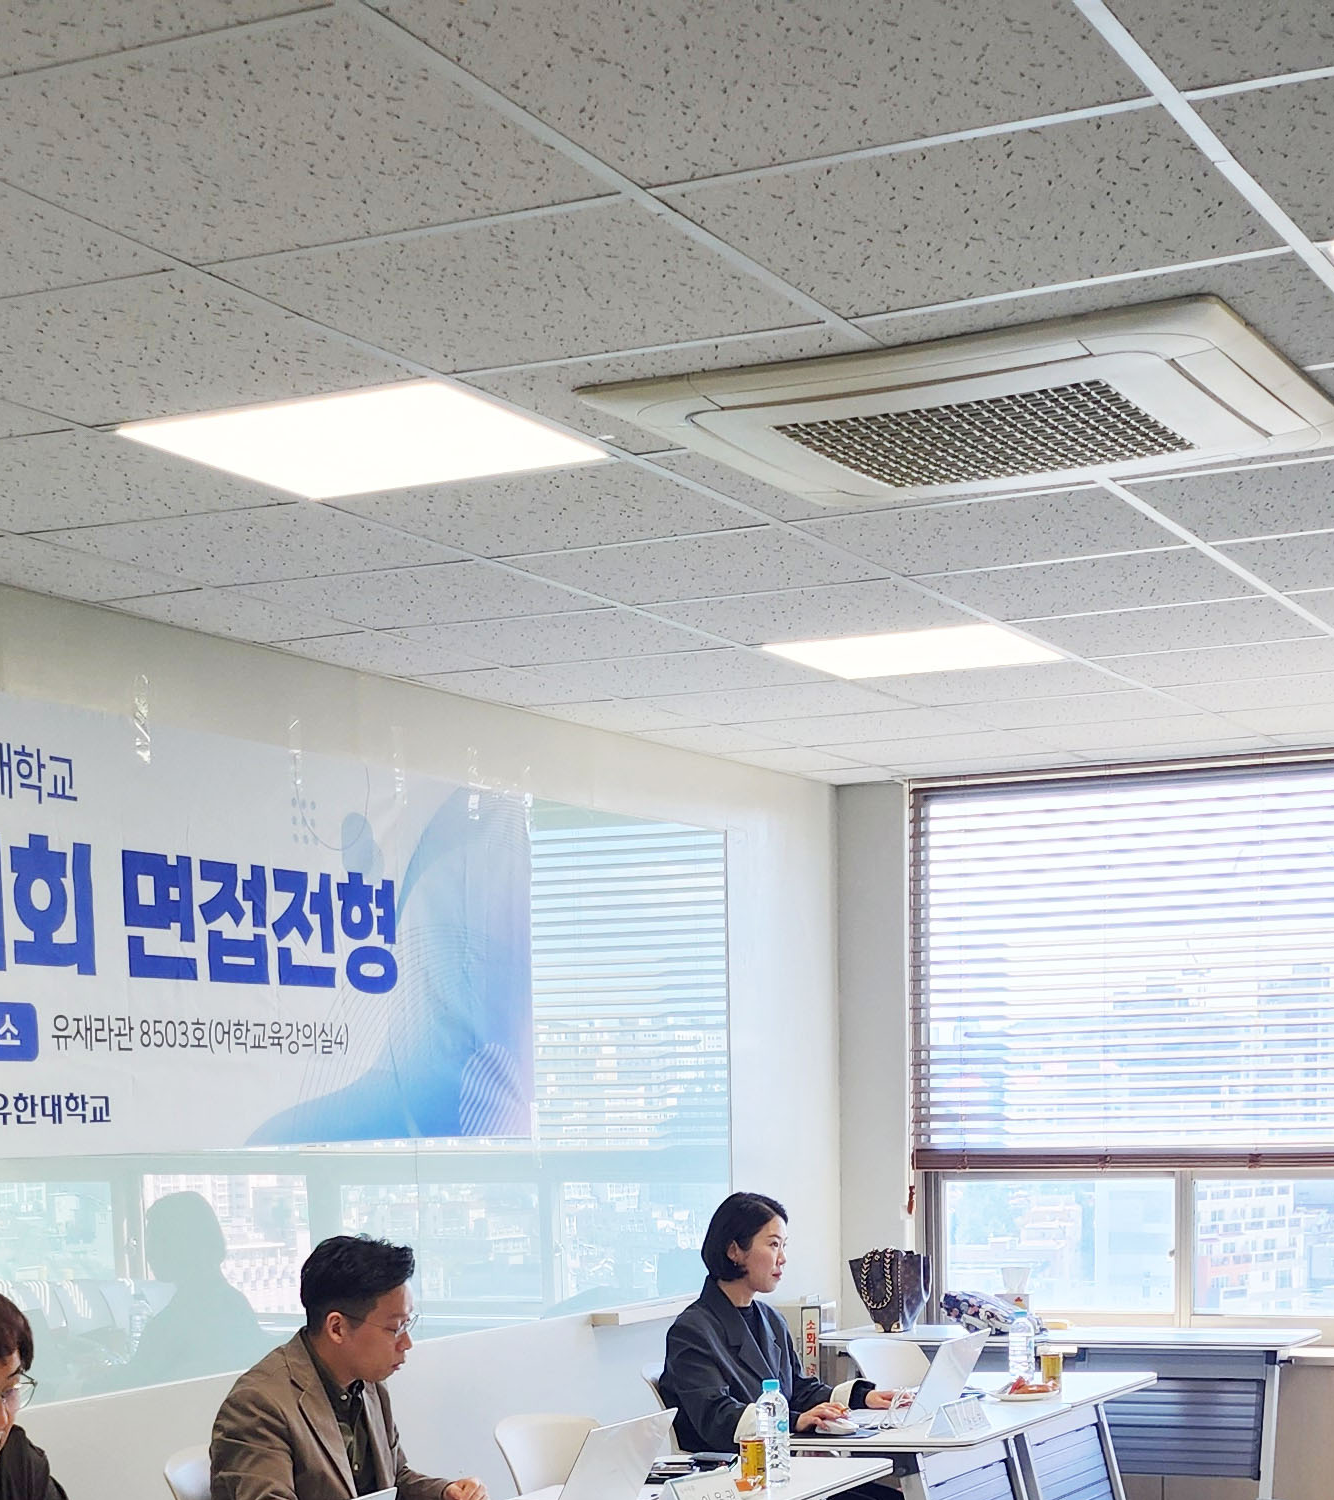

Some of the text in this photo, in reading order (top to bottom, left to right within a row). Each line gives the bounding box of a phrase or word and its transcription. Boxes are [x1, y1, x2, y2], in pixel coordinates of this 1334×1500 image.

[122, 849, 398, 994] 면접전형
[51, 1014, 134, 1052] 유재라관
[806, 1320, 817, 1357] 소화기
